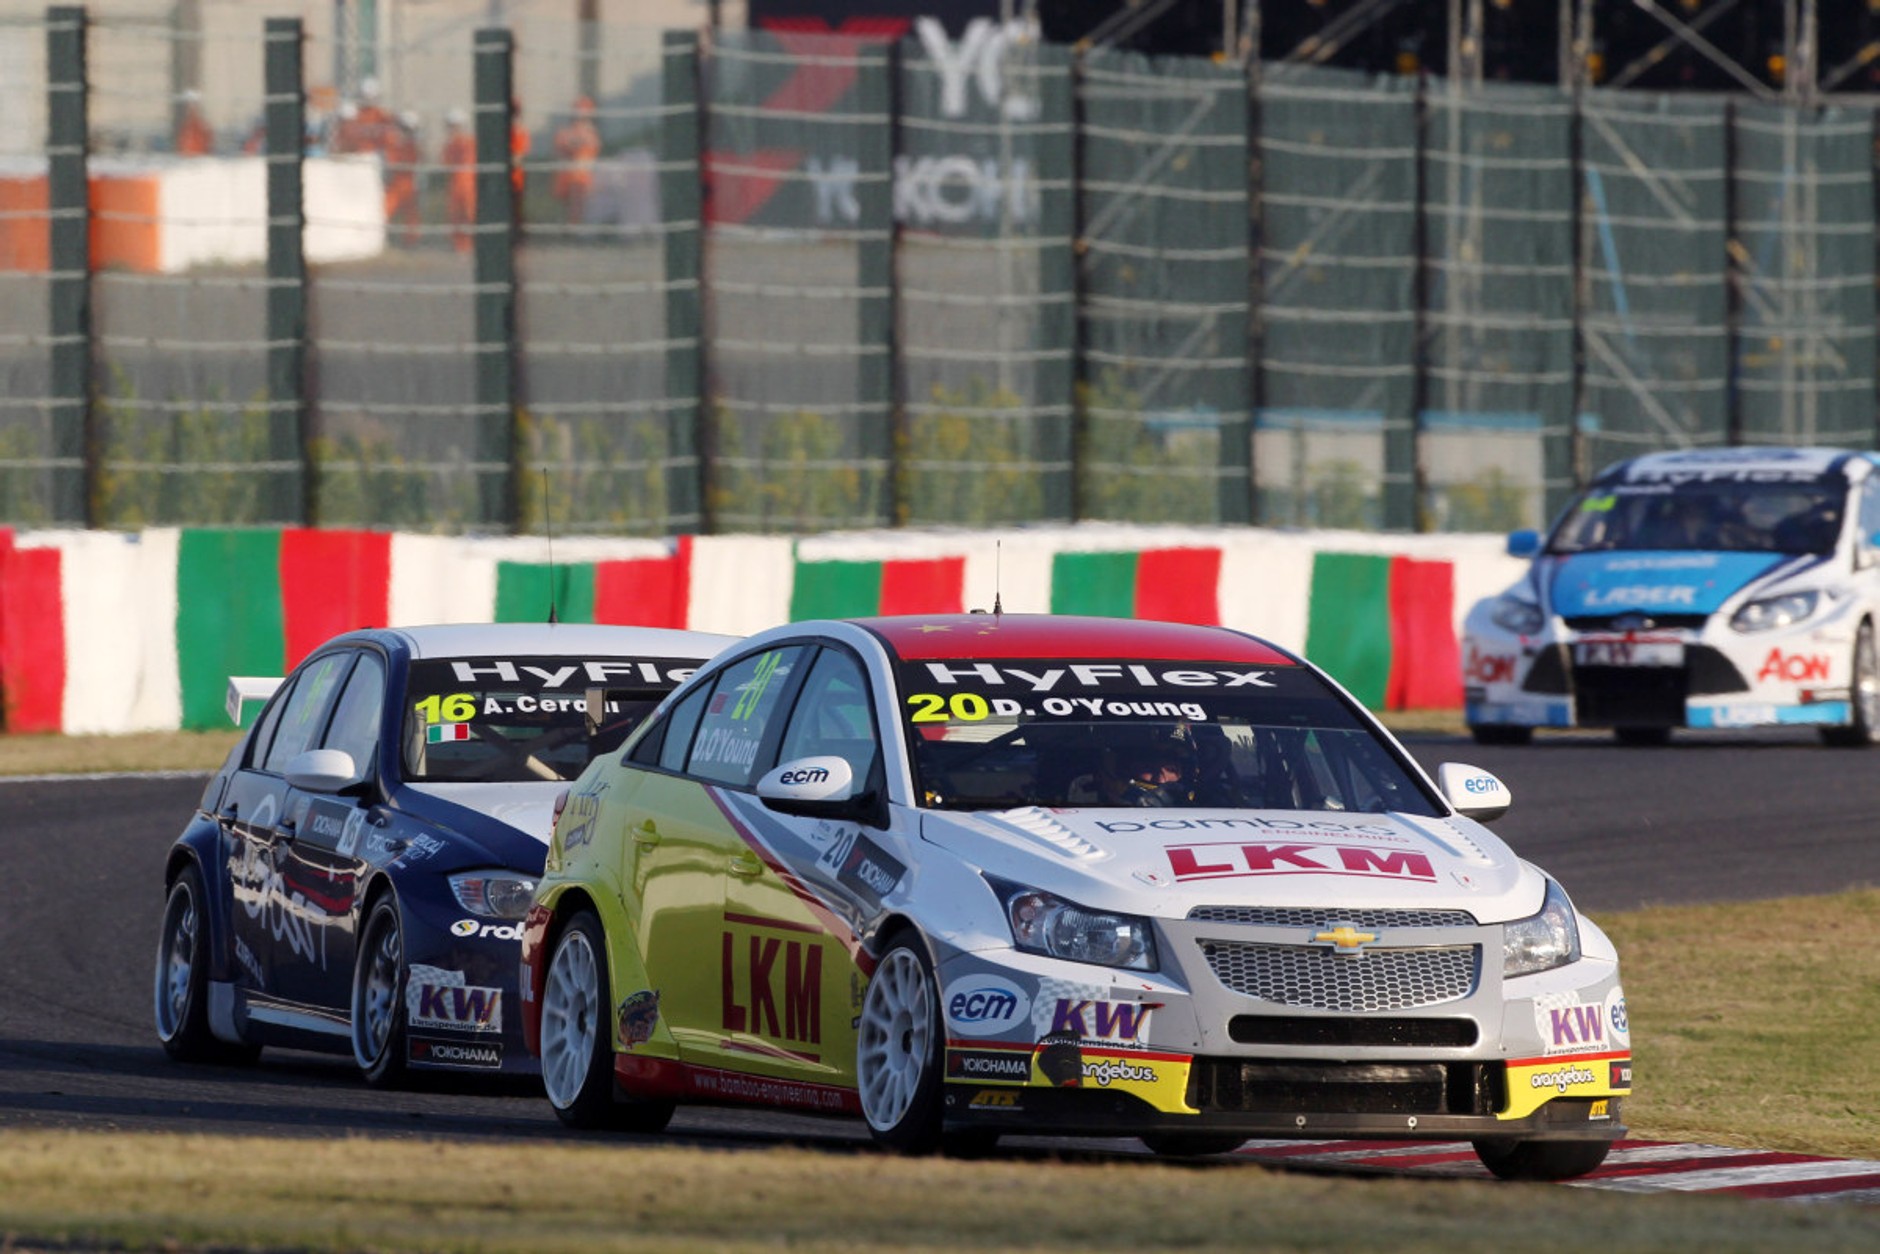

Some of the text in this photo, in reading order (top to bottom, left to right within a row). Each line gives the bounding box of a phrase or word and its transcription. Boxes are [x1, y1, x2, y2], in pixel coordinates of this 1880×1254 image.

[924, 662, 1279, 692] HyFlex
[415, 693, 477, 724] 16
[907, 692, 990, 723] 20
[1043, 697, 1209, 722] O'Young
[780, 767, 830, 785] ecm
[1464, 776, 1500, 794] ecm
[1095, 816, 1398, 836] bamboo
[822, 827, 854, 869] 20
[1165, 845, 1437, 879] LKM
[721, 931, 823, 1045] LKM
[420, 984, 499, 1024] KW
[948, 987, 1018, 1022] ecm
[1051, 998, 1150, 1041] KW
[1550, 1004, 1604, 1046] KW
[430, 1044, 499, 1062] YOKOHAMA
[962, 1058, 1028, 1075] YOKOHAMA
[1531, 1065, 1596, 1093] orangebus.
